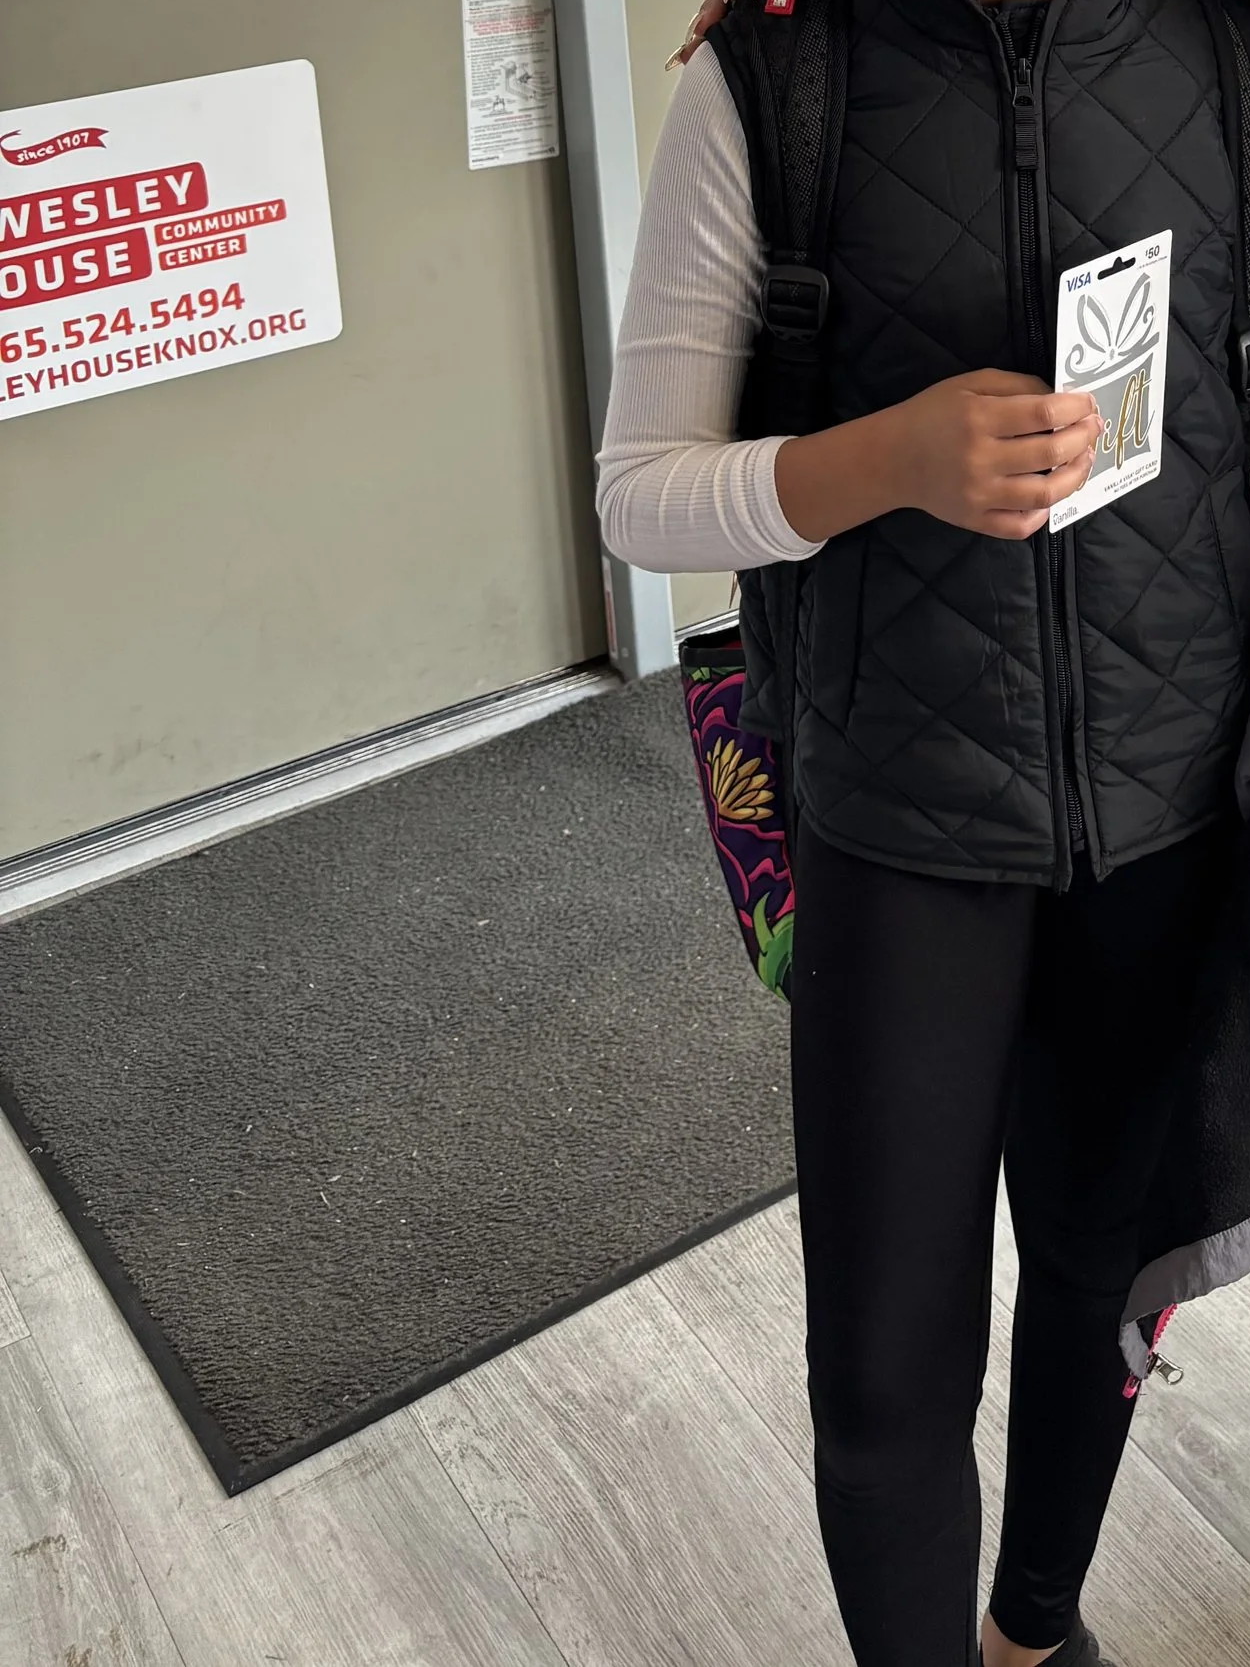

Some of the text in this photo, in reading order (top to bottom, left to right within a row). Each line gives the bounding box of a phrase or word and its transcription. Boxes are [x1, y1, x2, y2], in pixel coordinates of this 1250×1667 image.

[17, 132, 90, 163] since 1907
[0, 171, 193, 242] WESLEY
[162, 204, 280, 241] COMMUNITY
[165, 239, 242, 267] CENTER
[1066, 272, 1092, 293] VISA
[0, 283, 246, 364] 65.524.5494
[1092, 368, 1156, 471] ift
